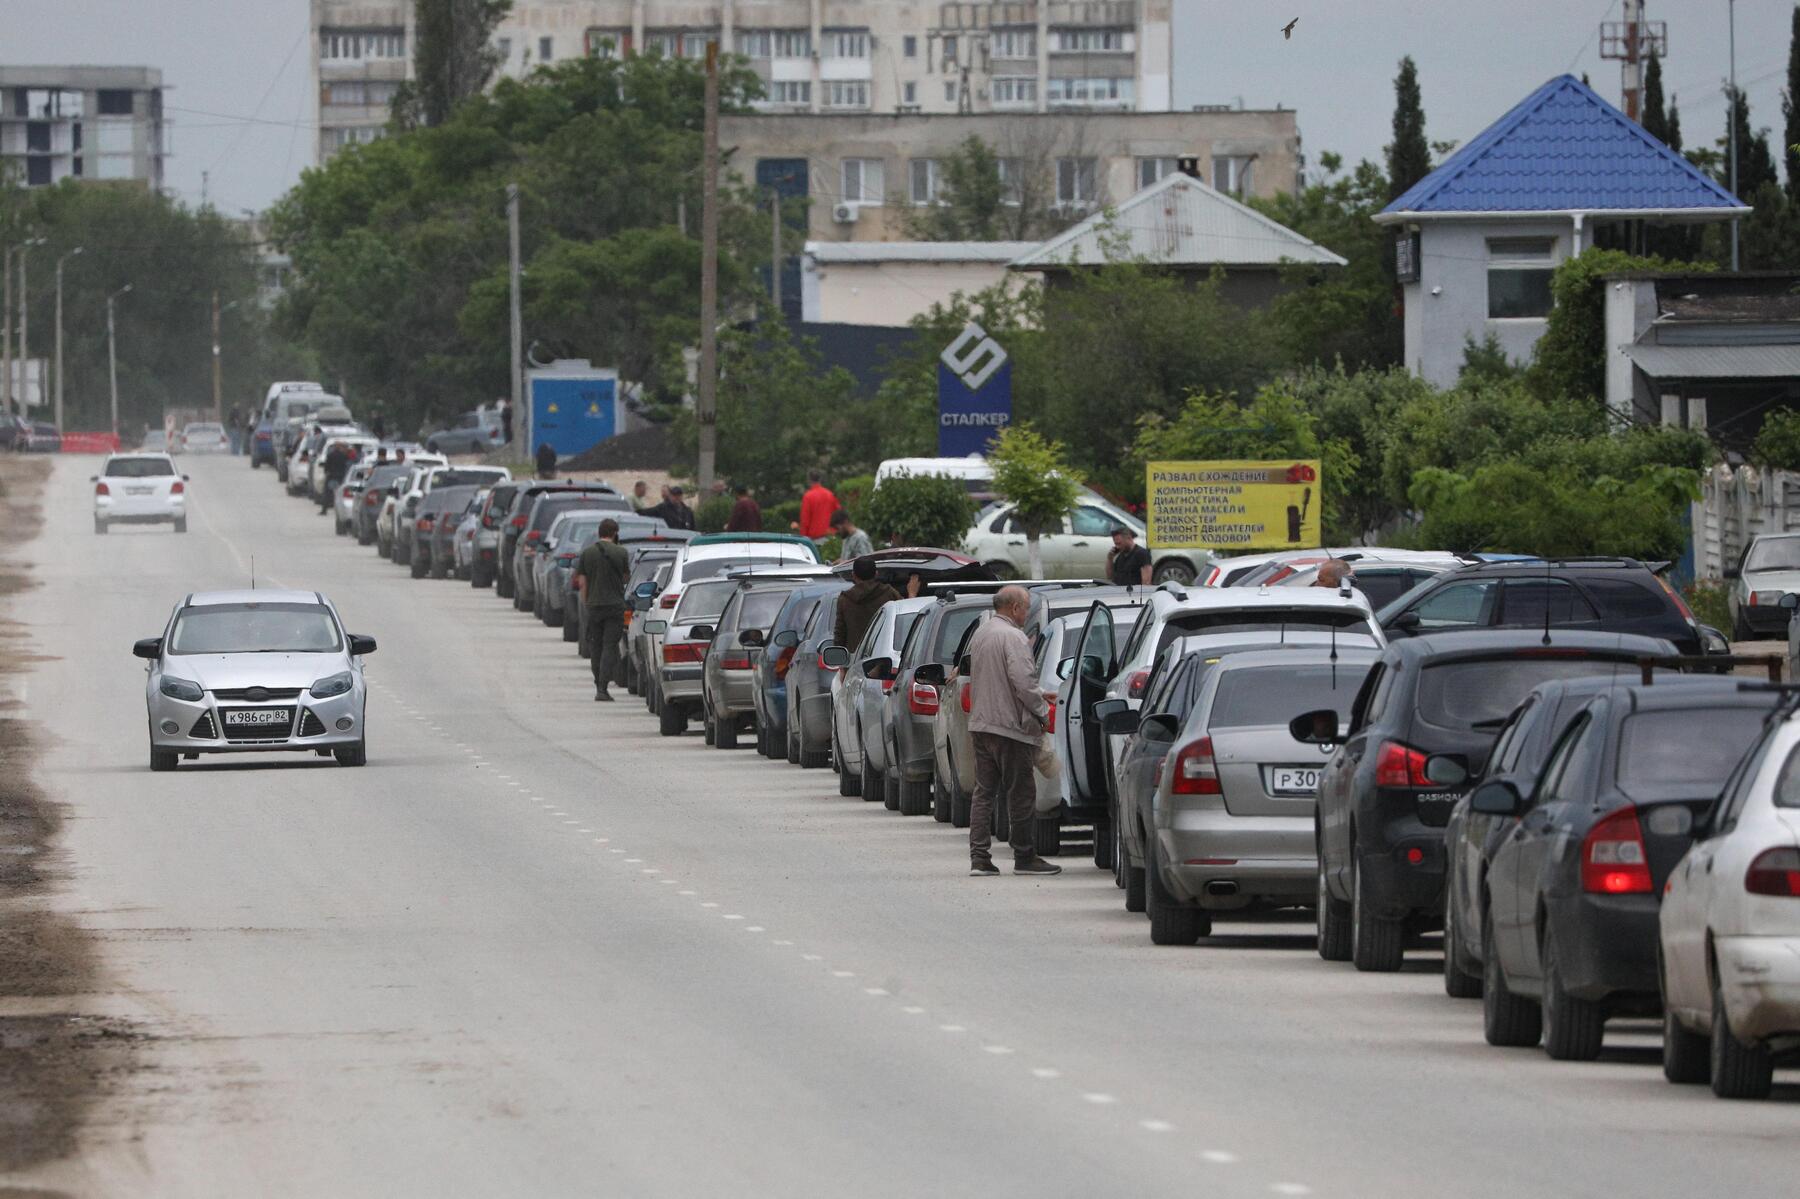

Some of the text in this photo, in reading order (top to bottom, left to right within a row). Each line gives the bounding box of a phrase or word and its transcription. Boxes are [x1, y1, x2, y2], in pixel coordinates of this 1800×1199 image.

[941, 412, 1009, 426] СТАЛКЕР
[1153, 472, 1196, 482] РАЗВАЛ
[1201, 505, 1236, 514] МАСЕЛ
[1238, 505, 1246, 514] И
[1201, 524, 1265, 534] ДВИГАТЕЛЕЙ
[1201, 534, 1251, 544] ХОДОВОЙ
